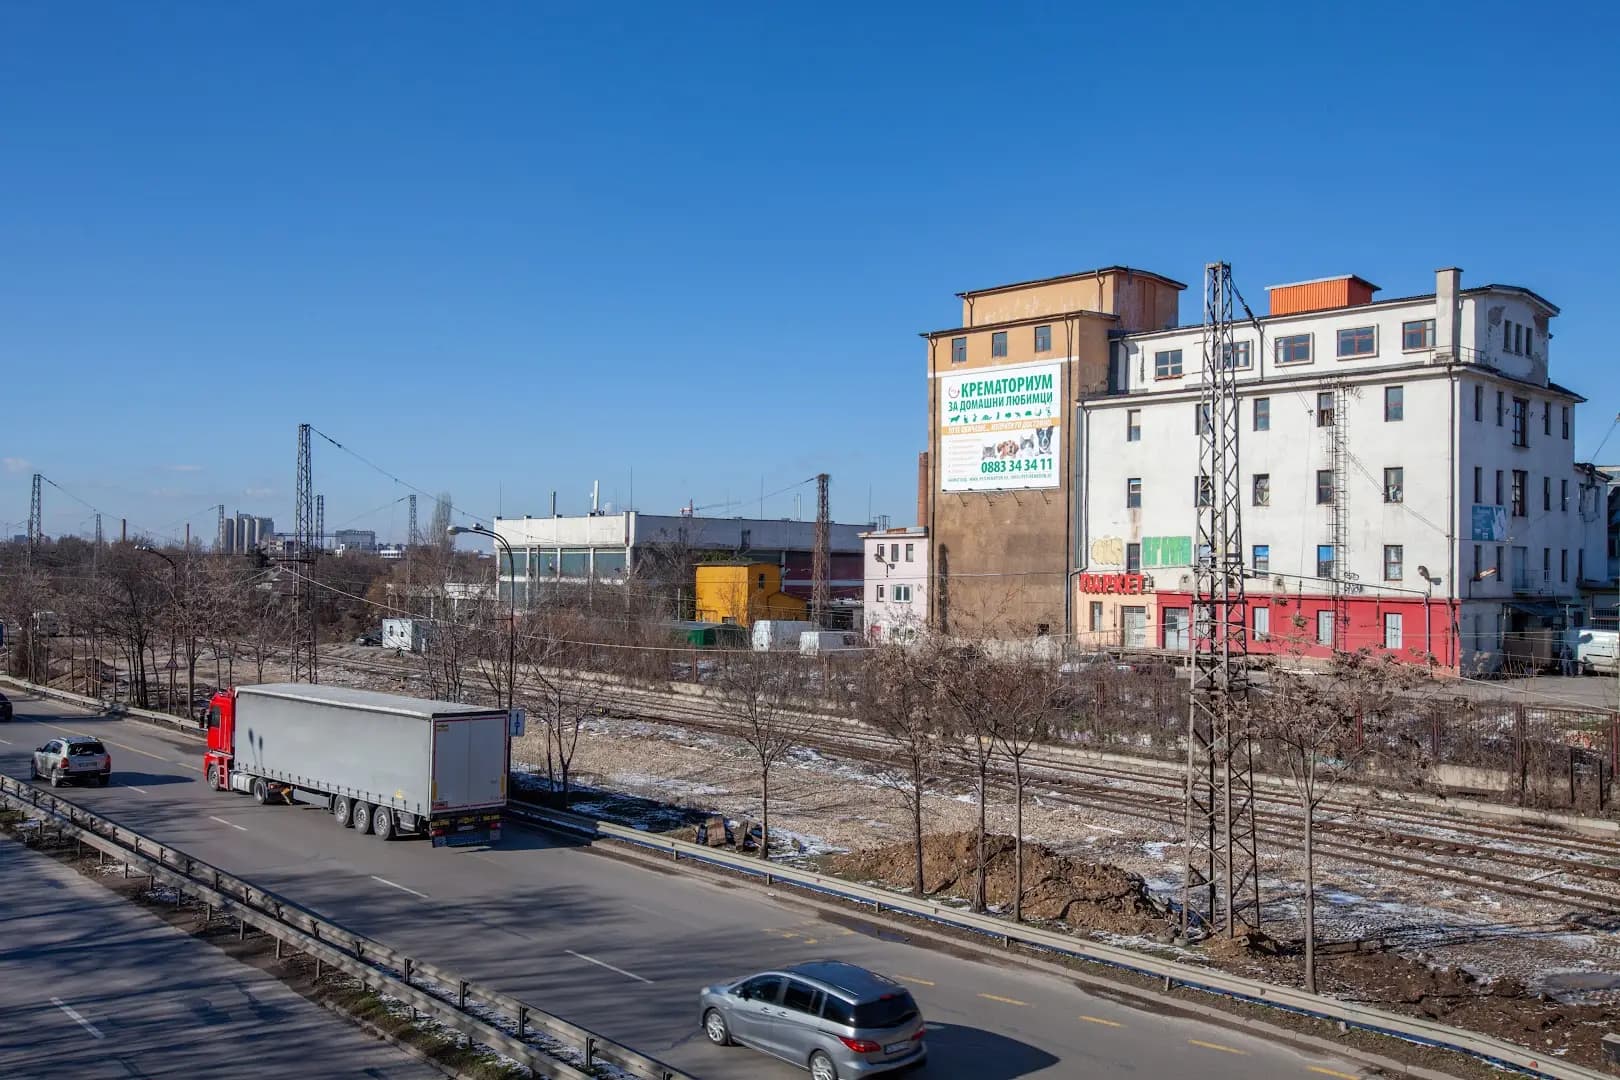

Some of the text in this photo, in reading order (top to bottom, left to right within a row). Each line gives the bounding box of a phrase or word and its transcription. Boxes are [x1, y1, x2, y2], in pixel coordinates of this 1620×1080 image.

[961, 374, 1053, 398] КРЕМАТОРИУМ
[948, 391, 1053, 412] ЗА ДОМАШНИ ЛЮБИМЦИ
[981, 457, 1053, 473] 0883 34 34 11
